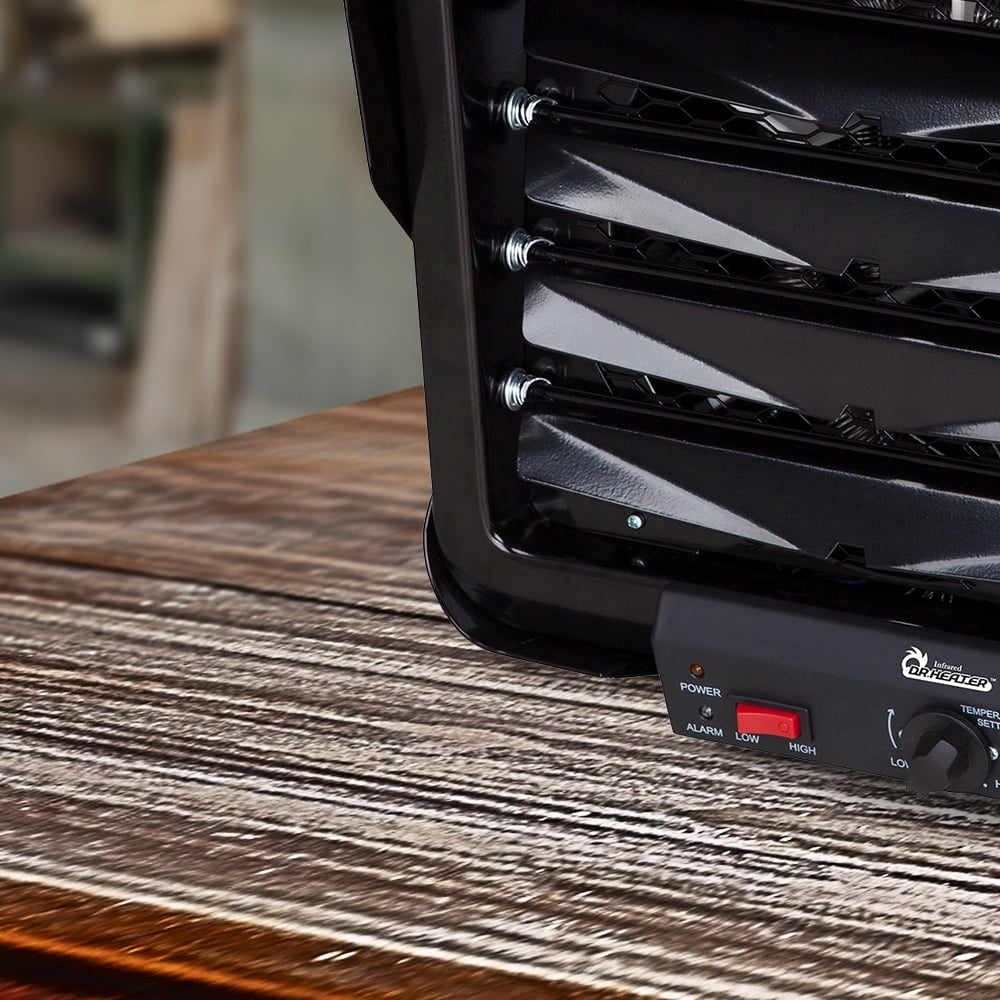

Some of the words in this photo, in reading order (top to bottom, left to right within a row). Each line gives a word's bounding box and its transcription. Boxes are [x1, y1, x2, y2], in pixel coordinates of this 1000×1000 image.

[934, 660, 963, 672] Infrared
[680, 682, 722, 698] POWER
[686, 723, 723, 737] ALARM
[735, 732, 760, 744] LOW
[789, 742, 817, 756] HIGH
